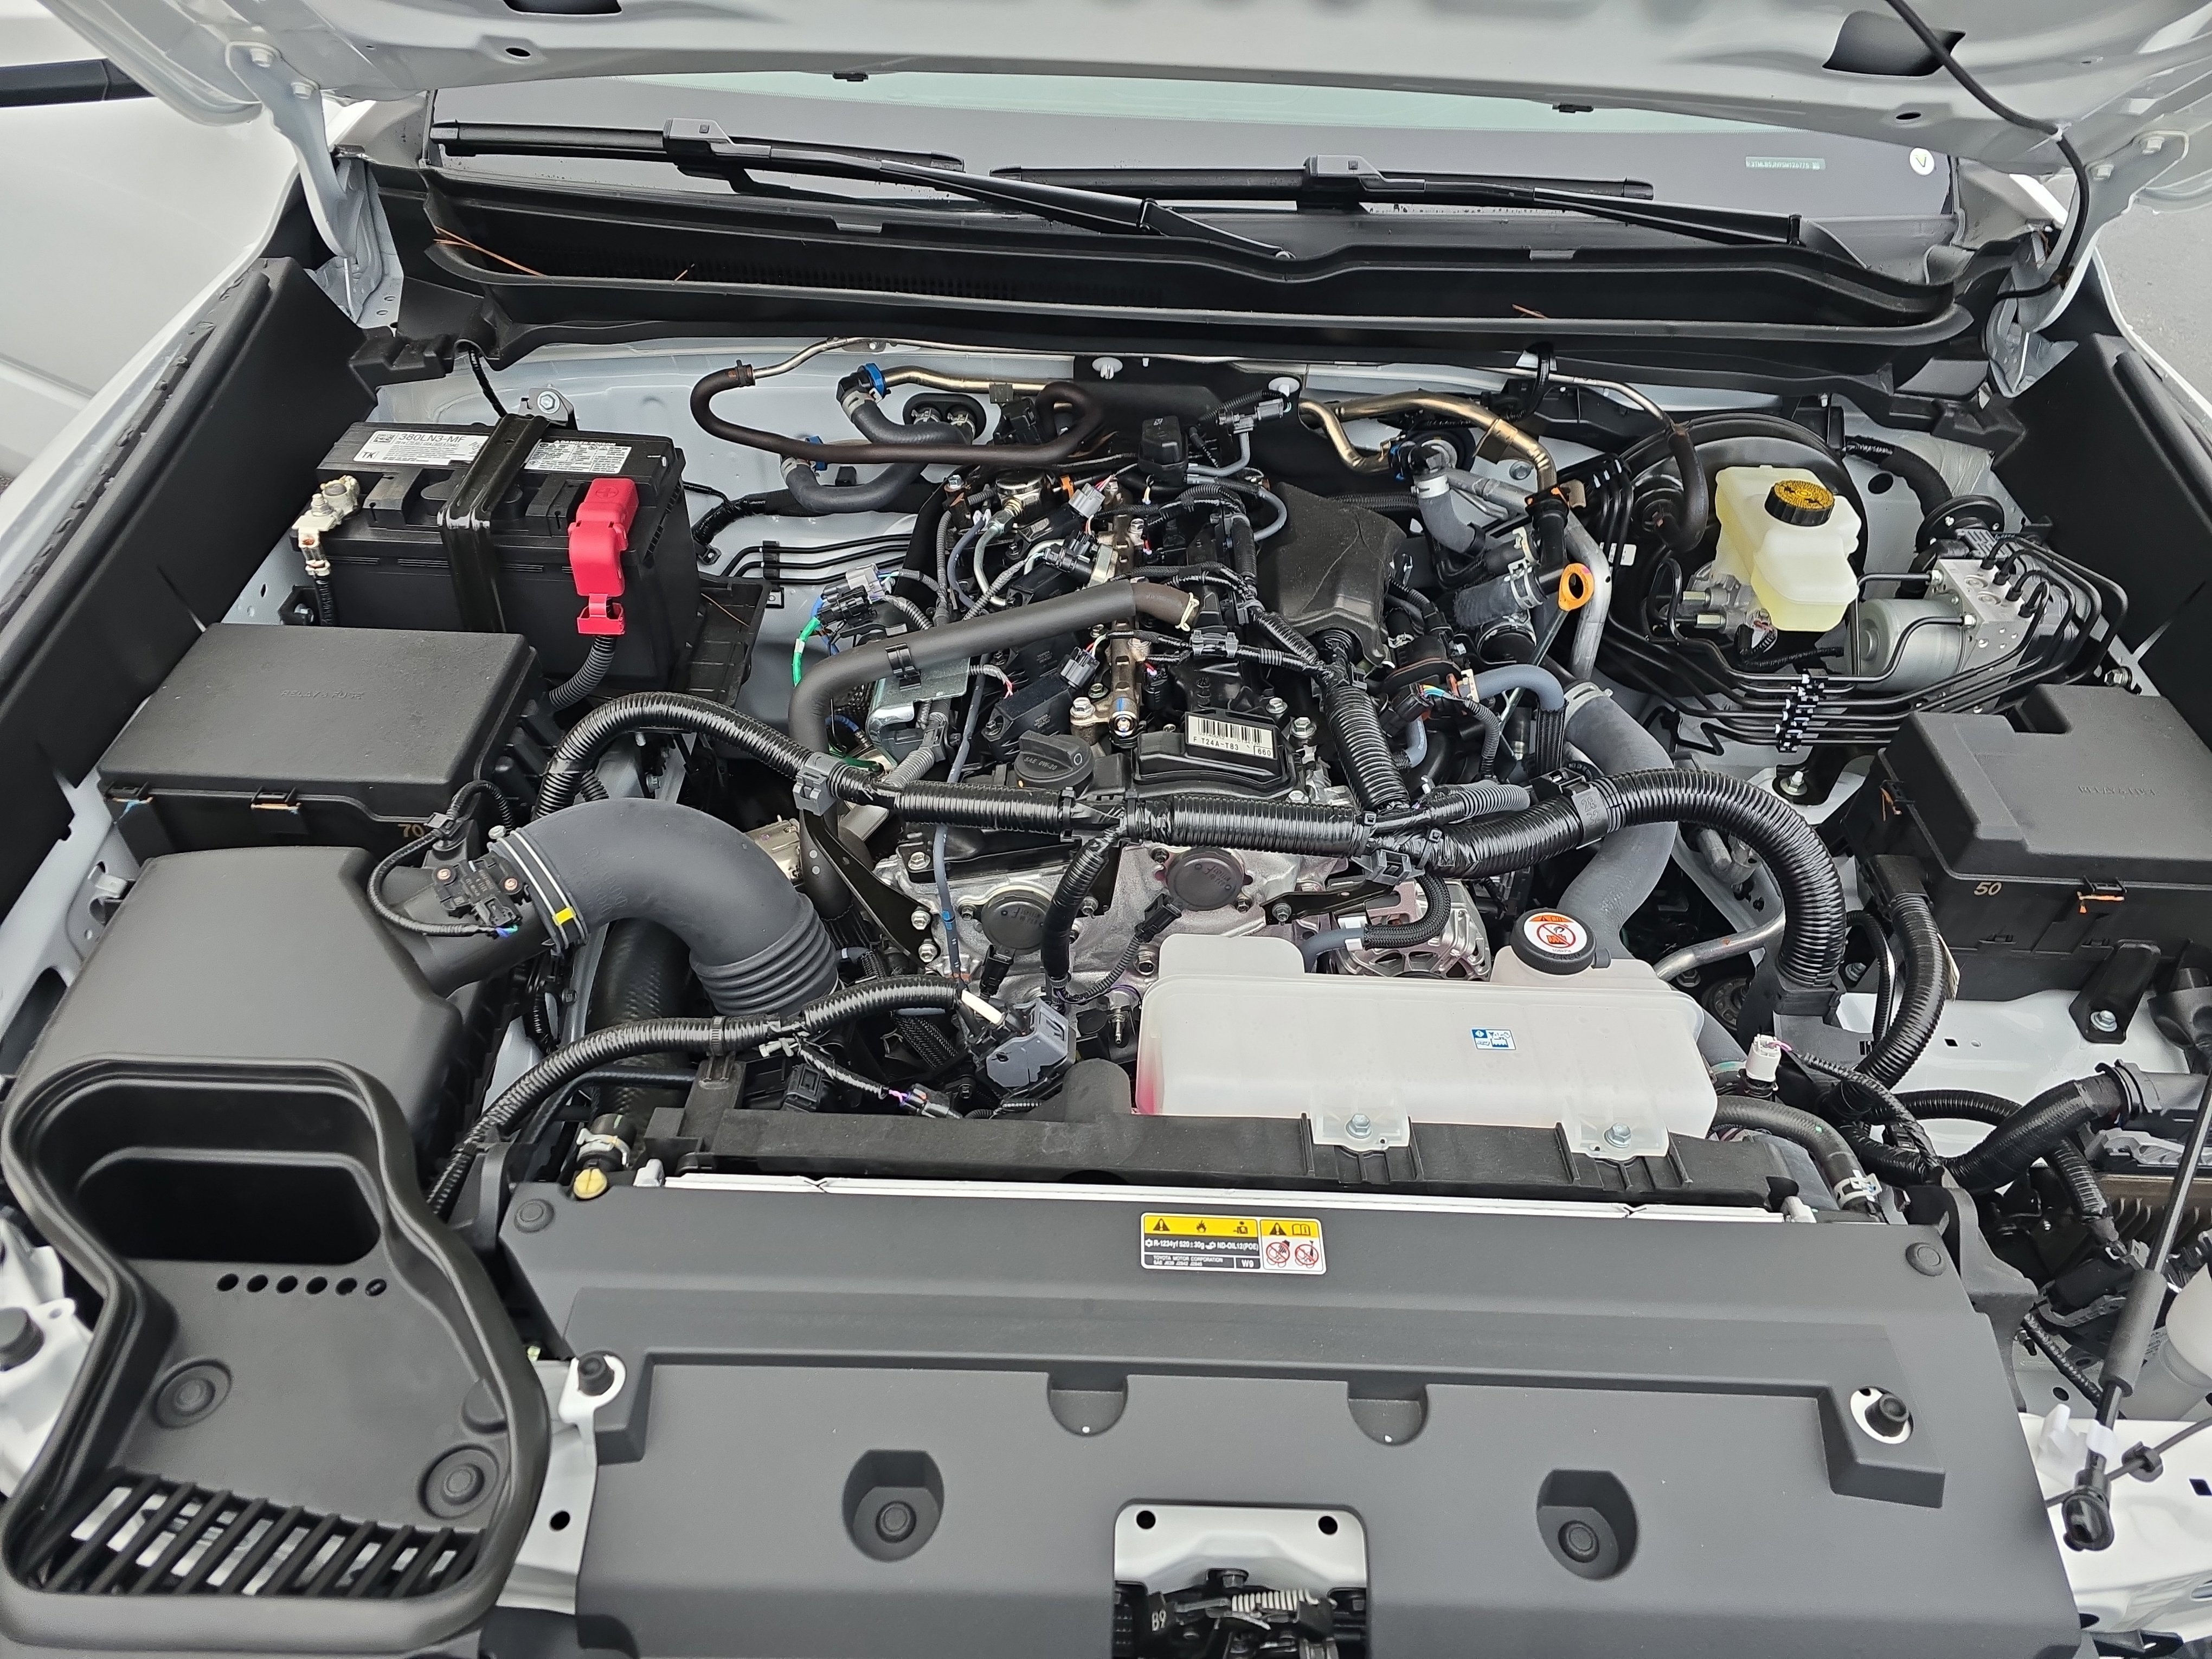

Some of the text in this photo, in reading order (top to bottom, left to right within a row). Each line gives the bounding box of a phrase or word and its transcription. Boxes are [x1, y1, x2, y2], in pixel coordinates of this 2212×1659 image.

[399, 434, 466, 443] 380LN3-MF
[281, 690, 321, 699] RELAY
[331, 690, 364, 700] FUSE
[1201, 737, 1239, 751] T24A-T83
[1038, 761, 1058, 770] 0W-20
[1581, 796, 1597, 813] 28
[397, 824, 425, 838] 70
[1973, 882, 2002, 896] 50
[1241, 1259, 1254, 1268] W9
